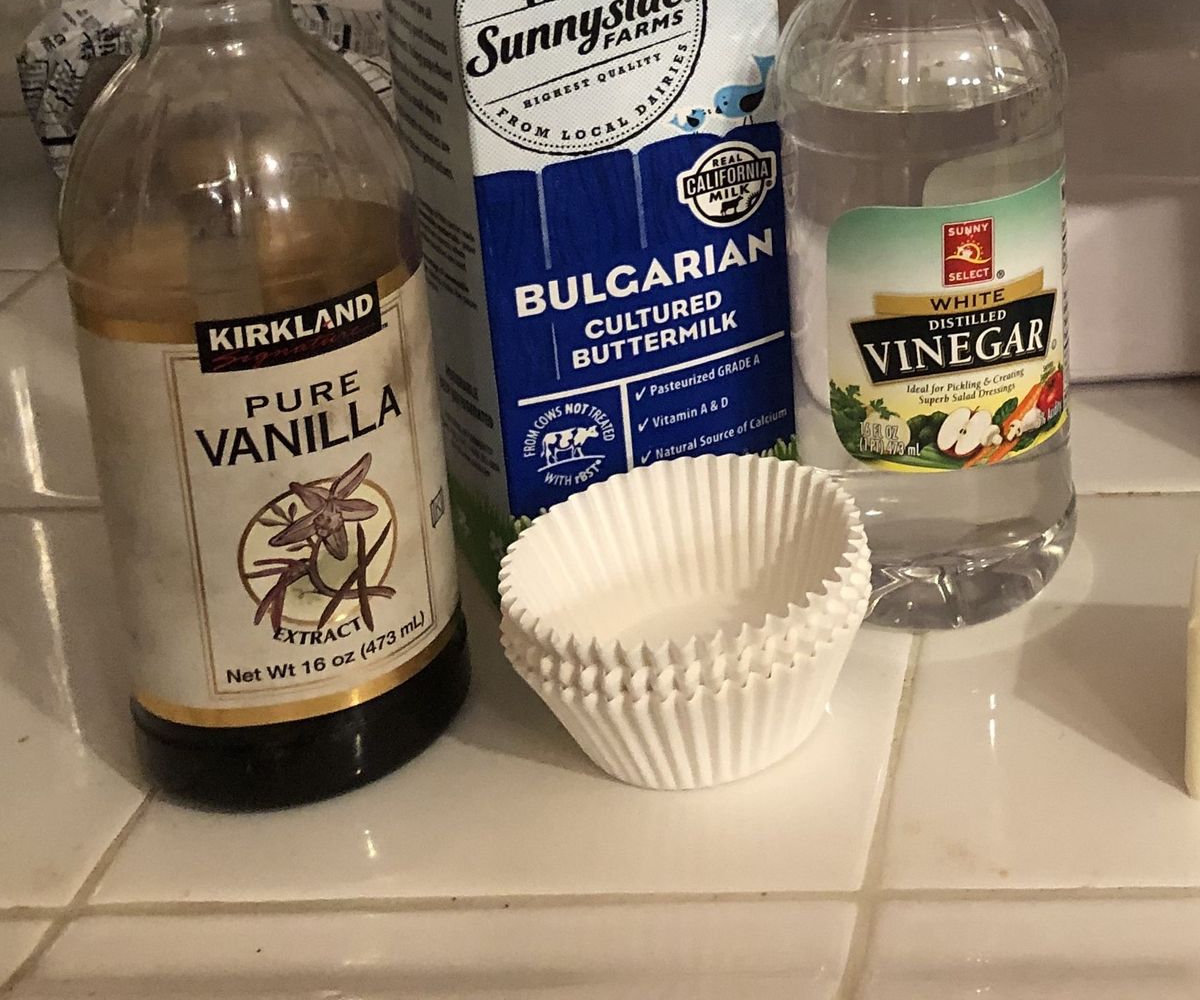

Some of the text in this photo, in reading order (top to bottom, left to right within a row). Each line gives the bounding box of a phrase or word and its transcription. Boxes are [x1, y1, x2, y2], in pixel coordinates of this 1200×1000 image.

[603, 9, 684, 50] FARMS
[496, 42, 689, 140] FROM LOCAL DAIRIES
[522, 52, 663, 109] HIGHEST QUALITY
[686, 160, 769, 196] CALIFORNIA
[712, 153, 743, 167] REAL
[708, 183, 750, 204] MILK
[948, 222, 990, 237] SUNNY
[515, 227, 774, 319] BULGARIAN
[948, 267, 990, 282] SELECT
[584, 290, 723, 341] CULTURED
[929, 309, 1007, 331] DISTILLED
[930, 288, 1006, 311] WHITE
[208, 292, 375, 352] KIRKLAND
[572, 309, 739, 370] BUTTERMILK
[863, 317, 1045, 377] VINEGAR
[245, 369, 361, 419] PURE
[650, 355, 752, 398] Pasteurized GRADE
[906, 368, 1025, 395] Ideal for Pickling Creating
[918, 382, 1016, 406] Superb Salad Dressings
[195, 383, 403, 468] VANILLA
[523, 402, 616, 458] FROM COWS NOT TREATED
[652, 407, 698, 429] Vitamin
[655, 406, 788, 460] Natural Source Calcium
[544, 471, 573, 486] WITH
[226, 610, 426, 684] Net Wt 16 oz (473 mL)
[272, 616, 363, 646] EXTRACT
